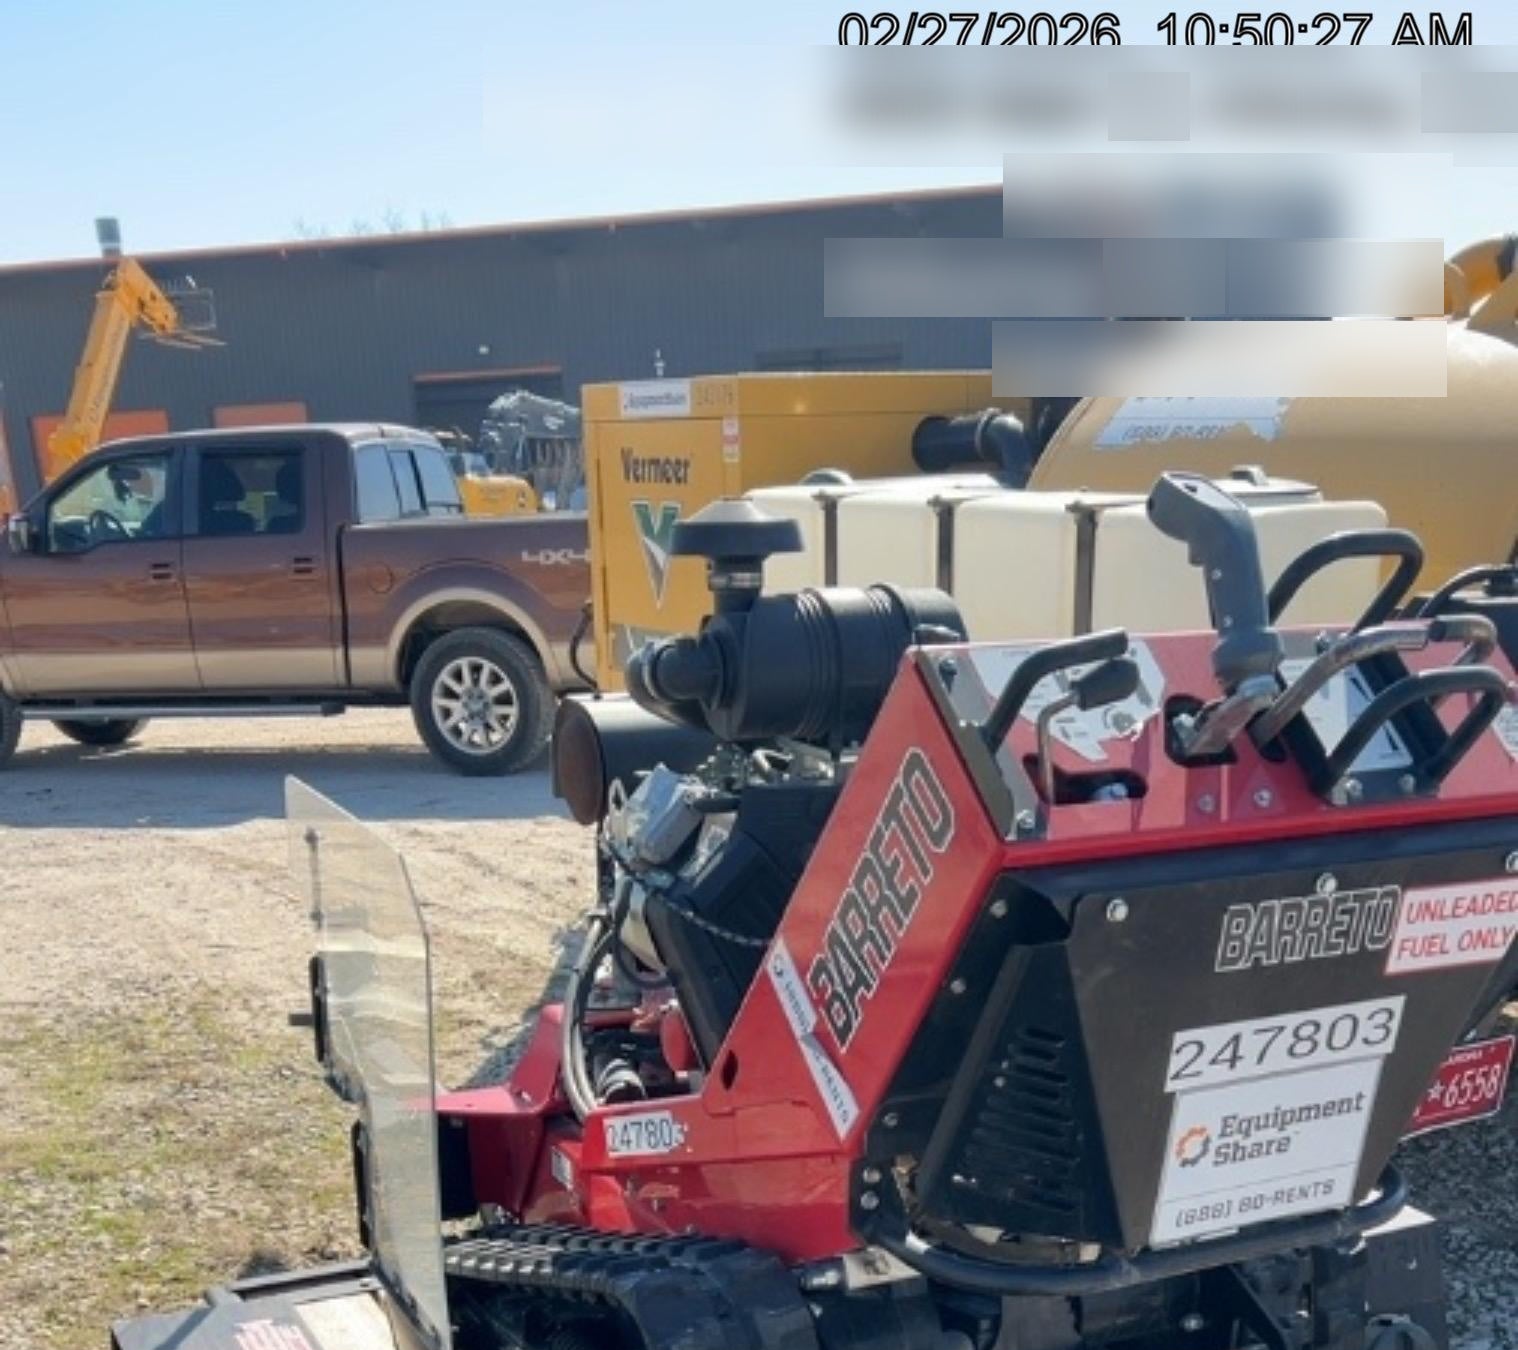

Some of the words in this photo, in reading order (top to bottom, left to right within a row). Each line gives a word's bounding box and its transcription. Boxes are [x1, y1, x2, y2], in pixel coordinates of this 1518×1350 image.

[620, 447, 691, 484] Vermeer
[806, 746, 955, 1054] BARRETO
[1214, 885, 1401, 972] BARRETO
[1397, 933, 1450, 960] FUEL
[1458, 925, 1516, 951] ONLY
[1169, 1007, 1395, 1081] 247803
[1442, 1063, 1500, 1108] 6558
[1218, 1091, 1367, 1139] Equipment
[1212, 1135, 1292, 1167] Share
